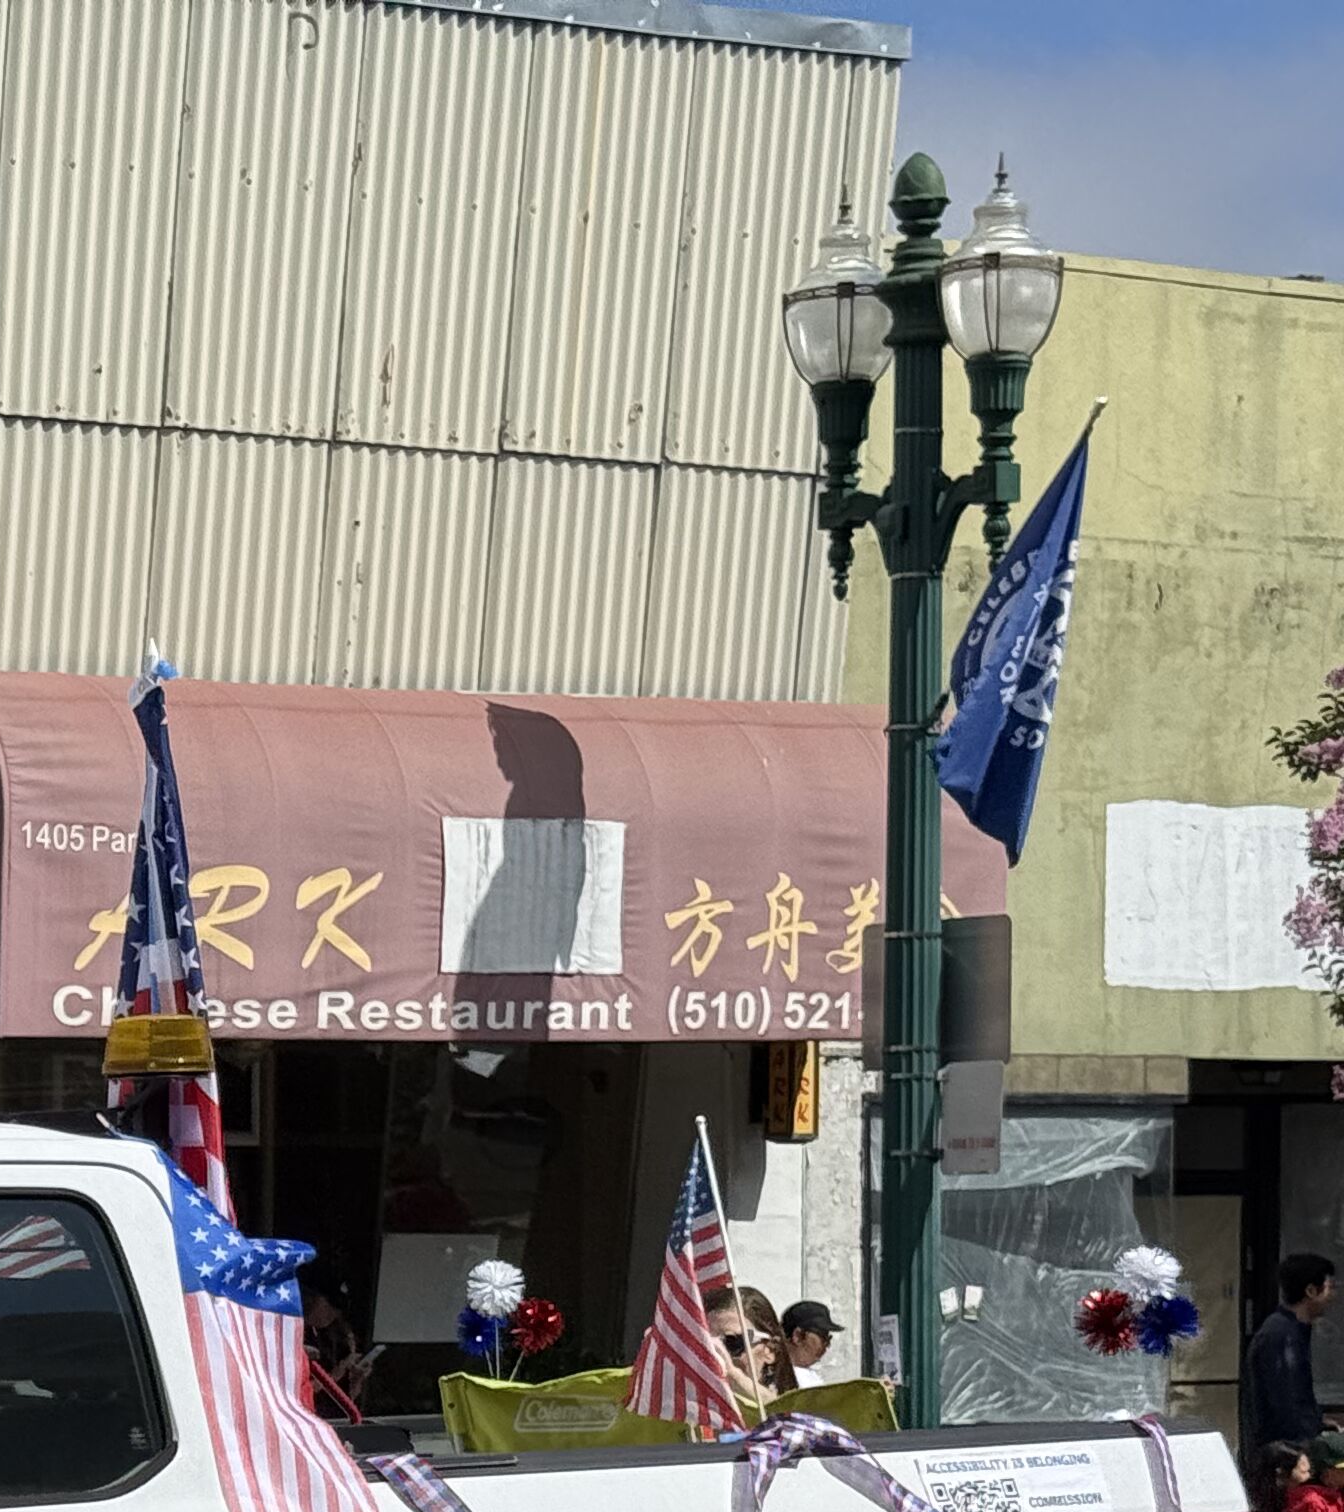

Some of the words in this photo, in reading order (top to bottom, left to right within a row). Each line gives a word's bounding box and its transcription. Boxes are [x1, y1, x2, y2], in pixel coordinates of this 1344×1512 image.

[21, 821, 86, 851] 1405
[316, 990, 633, 1031] Restaurant
[667, 986, 771, 1036] (510)
[925, 1459, 1008, 1474] ACCESSIBILITY
[1010, 1457, 1025, 1470] IS
[1026, 1453, 1091, 1469] BELONGING
[1028, 1492, 1104, 1508] COMMISSION
